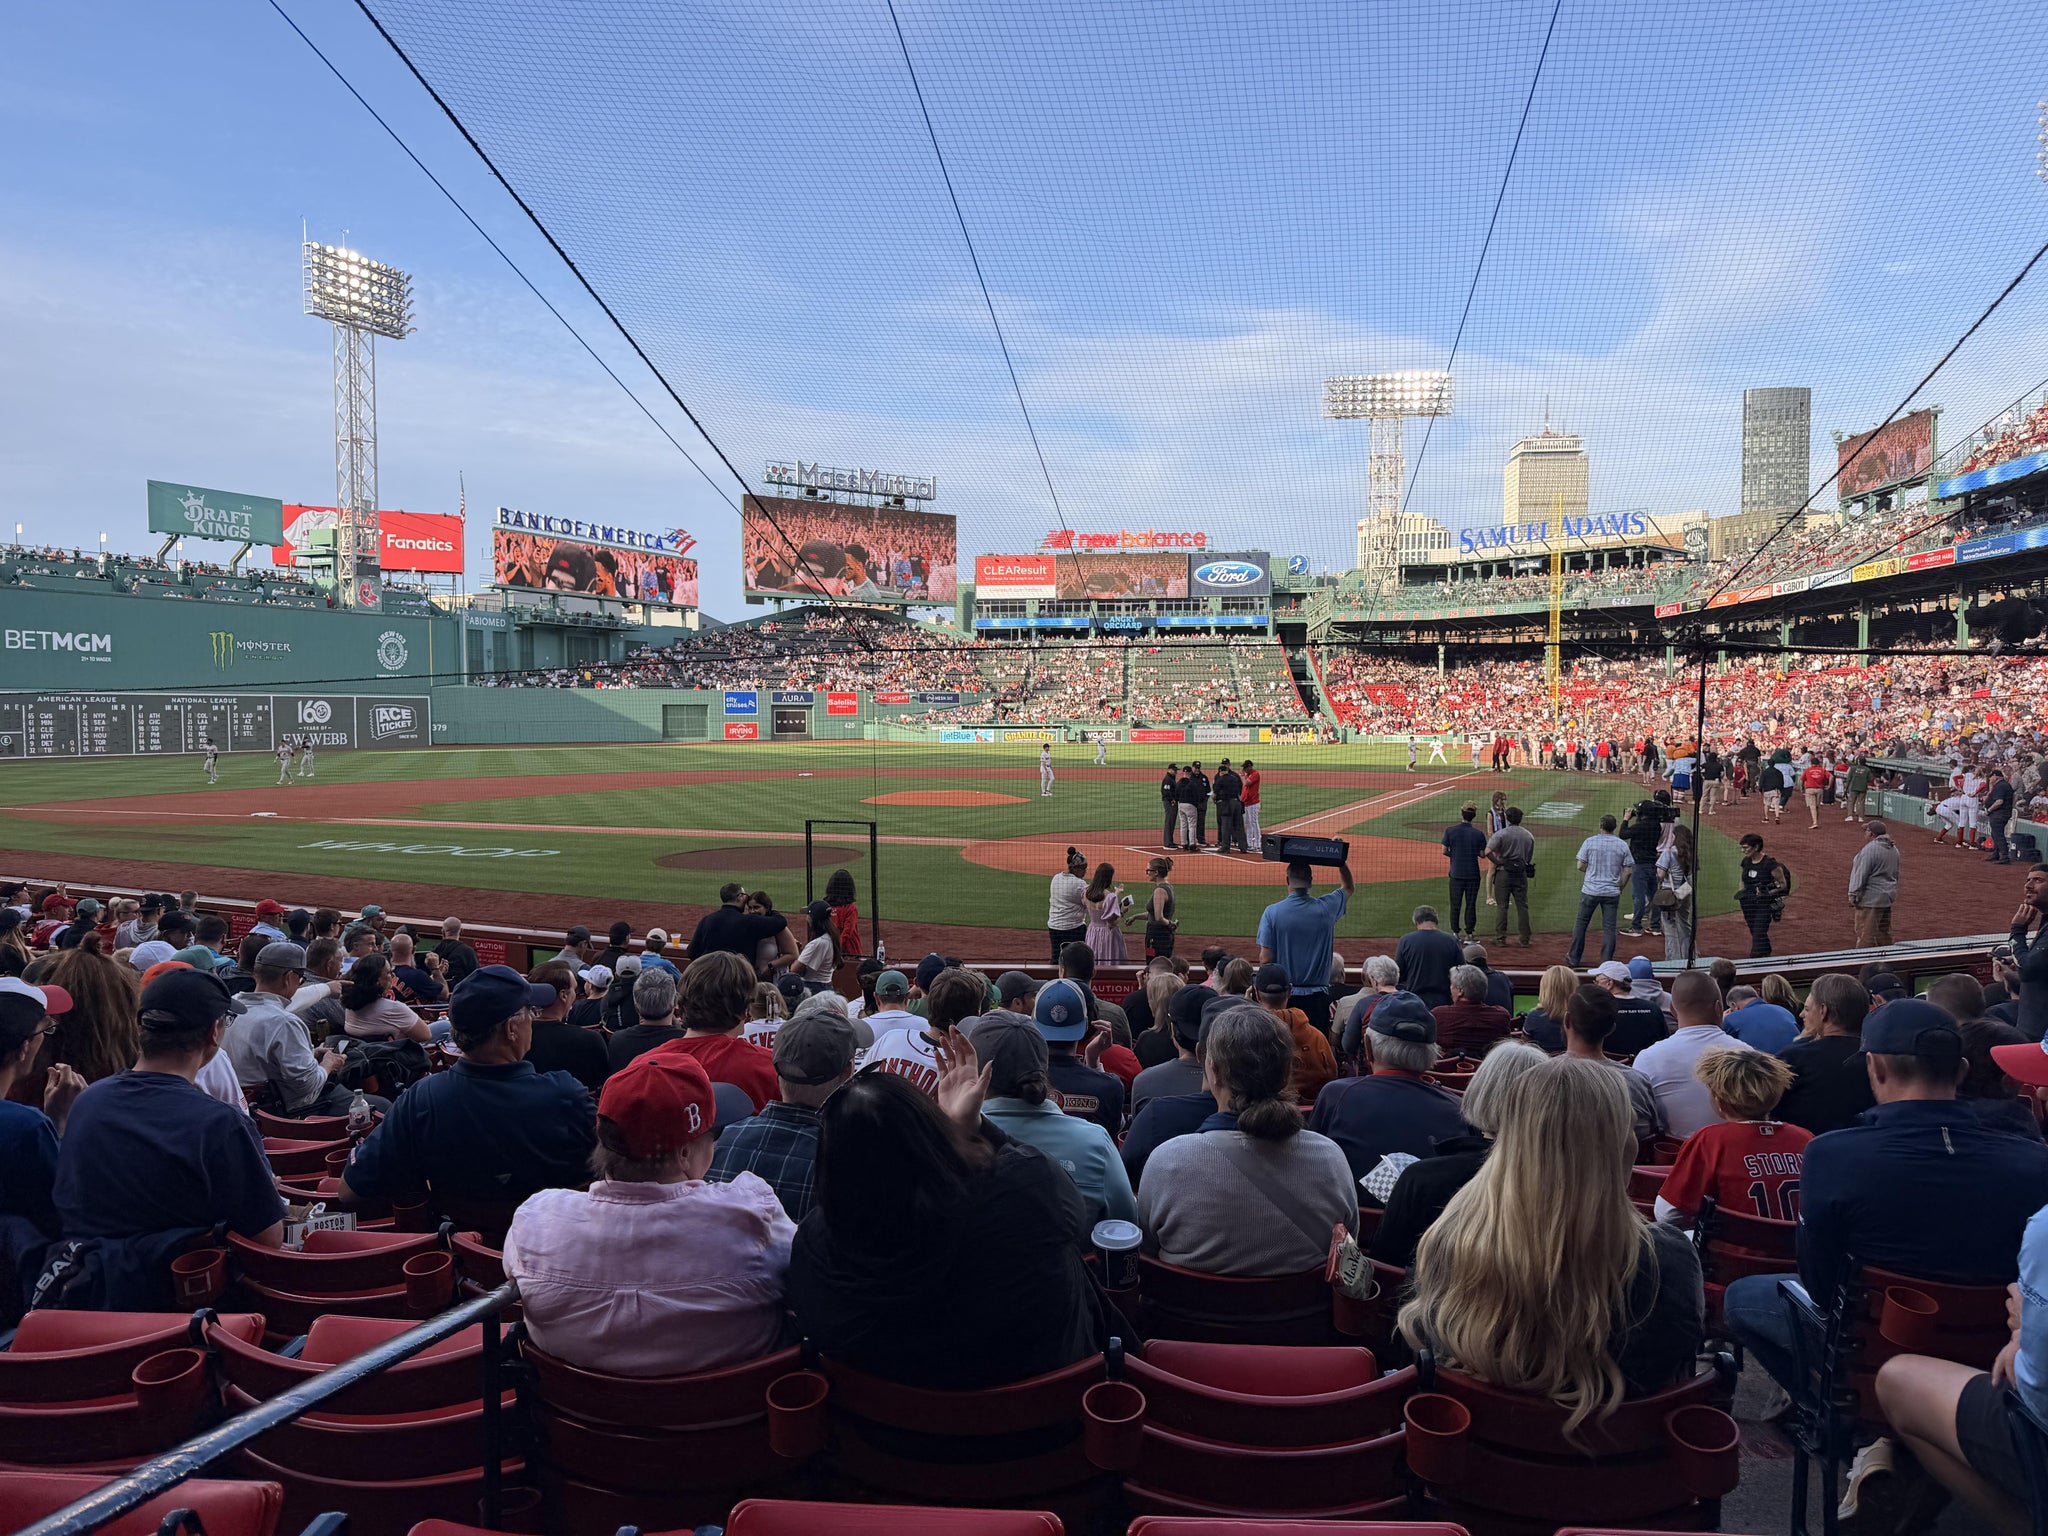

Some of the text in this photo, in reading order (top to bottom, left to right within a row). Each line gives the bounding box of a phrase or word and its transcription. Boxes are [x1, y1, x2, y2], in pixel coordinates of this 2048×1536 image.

[796, 460, 936, 500] MassMutual
[184, 505, 252, 526] DRAFT
[192, 520, 250, 539] KINGS
[499, 508, 664, 550] BANK OF AMERICA
[1460, 511, 1646, 554] SAMUEL ADAMS
[1684, 522, 1708, 532] BOSTON
[386, 533, 454, 552] Fanatics
[1078, 528, 1207, 548] new balance
[984, 565, 1048, 576] CLEAResult
[1207, 565, 1249, 583] Ford
[1612, 598, 1632, 606] 6:42
[469, 616, 506, 627] ABIOMED
[1104, 622, 1142, 630] ORCHARD
[4, 629, 112, 652] BETMGM
[378, 630, 396, 642] IBEW
[236, 640, 291, 652] MONSTER
[298, 700, 332, 724] 160
[375, 706, 412, 722] ACE
[380, 719, 412, 732] TICKET
[432, 724, 448, 732] 379
[729, 727, 753, 735] IRVING
[308, 732, 348, 745] WEBB
[944, 731, 970, 742] jetBlue
[1005, 731, 1056, 741] GRANITE CITY
[297, 840, 560, 858] WHOOP
[1316, 846, 1340, 854] ULTRA
[684, 1102, 701, 1134] B
[314, 1216, 345, 1230] BOSTON
